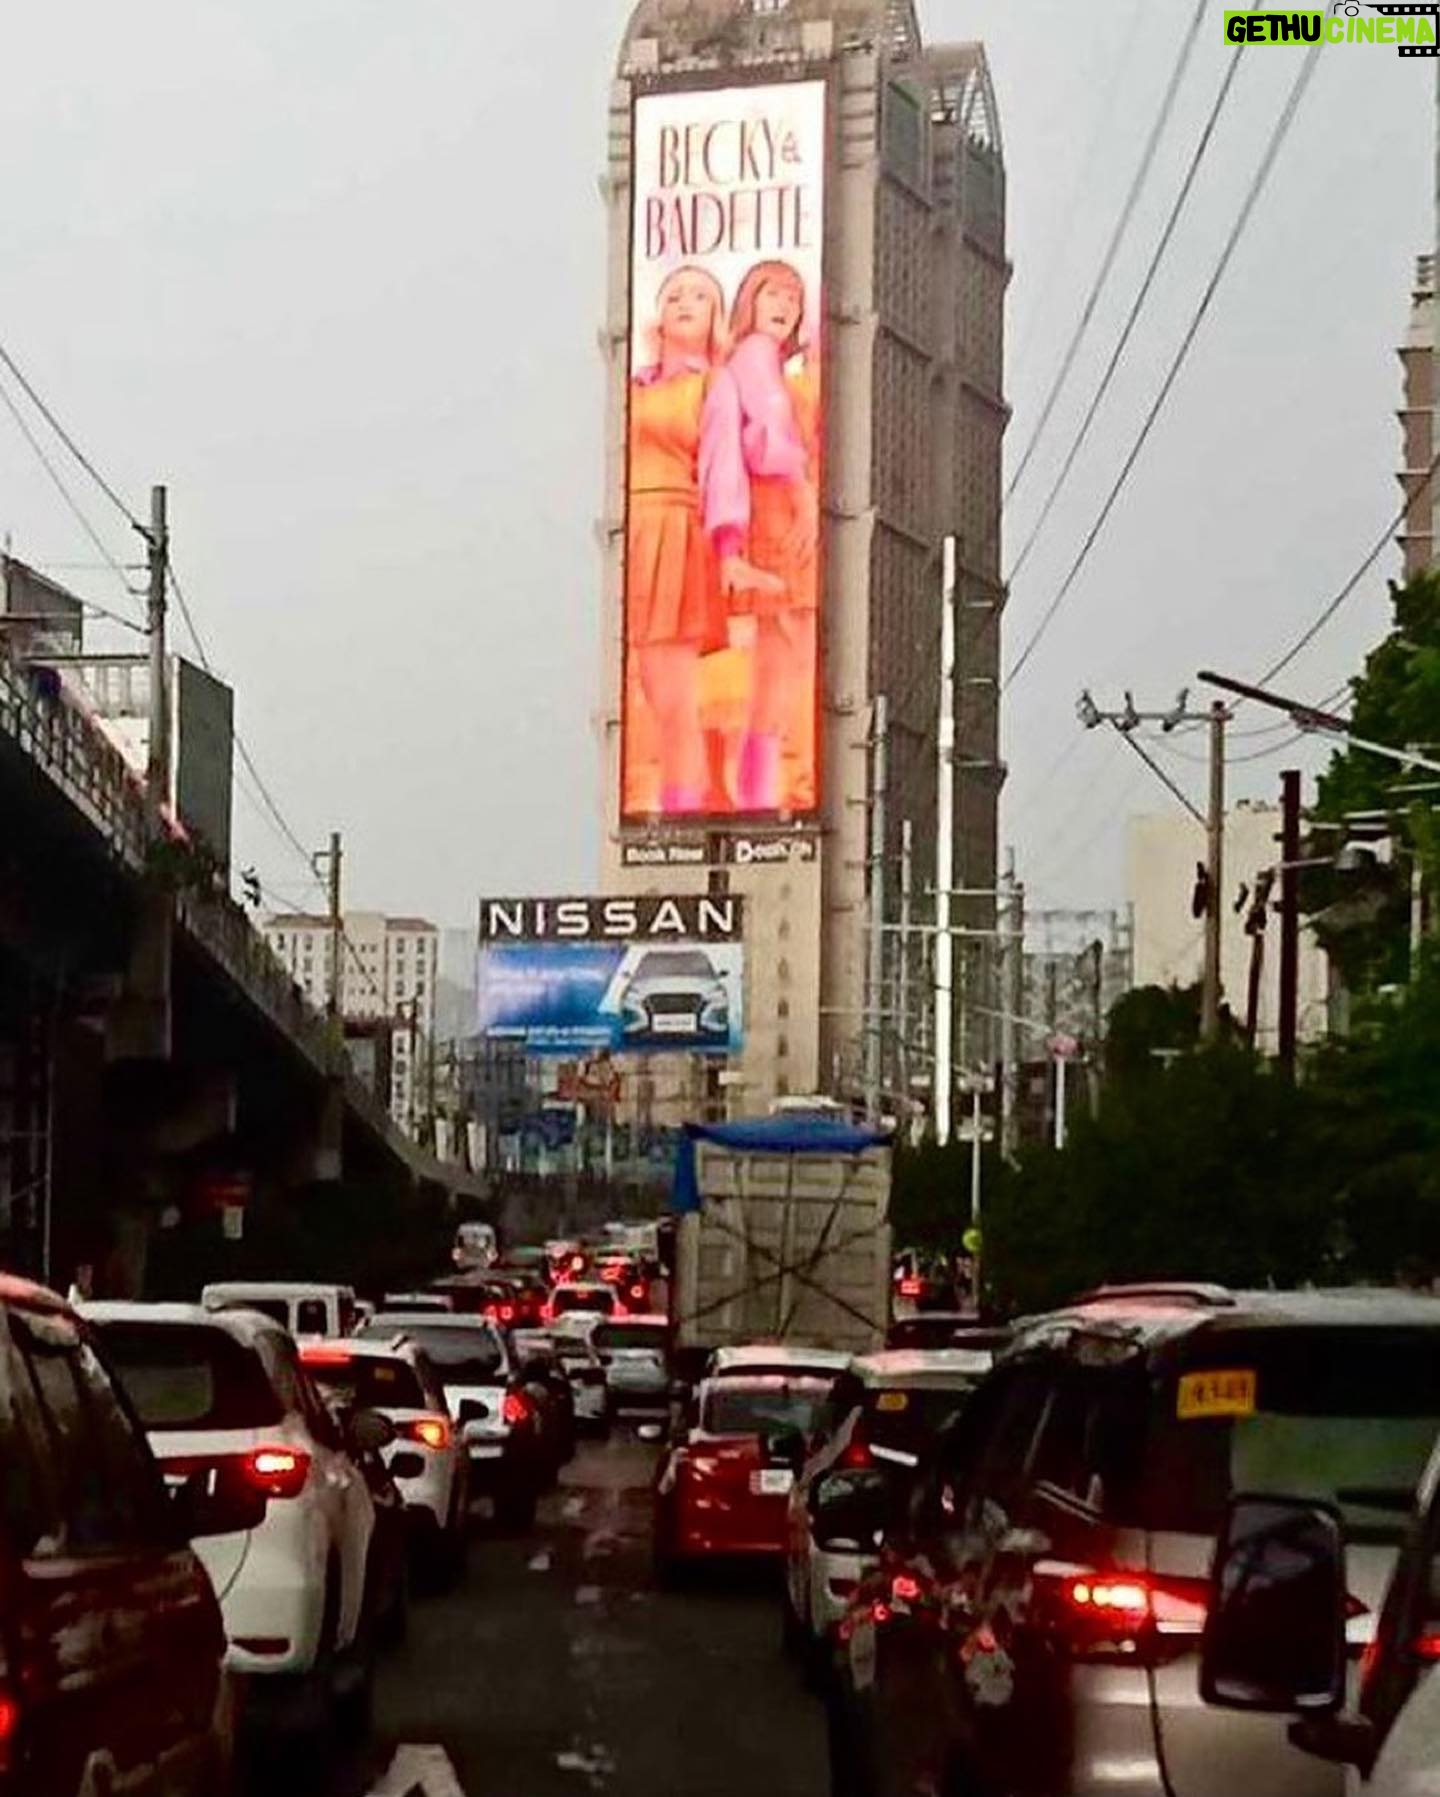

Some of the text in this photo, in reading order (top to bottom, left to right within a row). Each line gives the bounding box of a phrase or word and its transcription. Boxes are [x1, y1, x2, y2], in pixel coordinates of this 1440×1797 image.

[659, 117, 784, 189] BECKY
[646, 184, 813, 261] BADETTE
[489, 900, 734, 936] NISSAN
